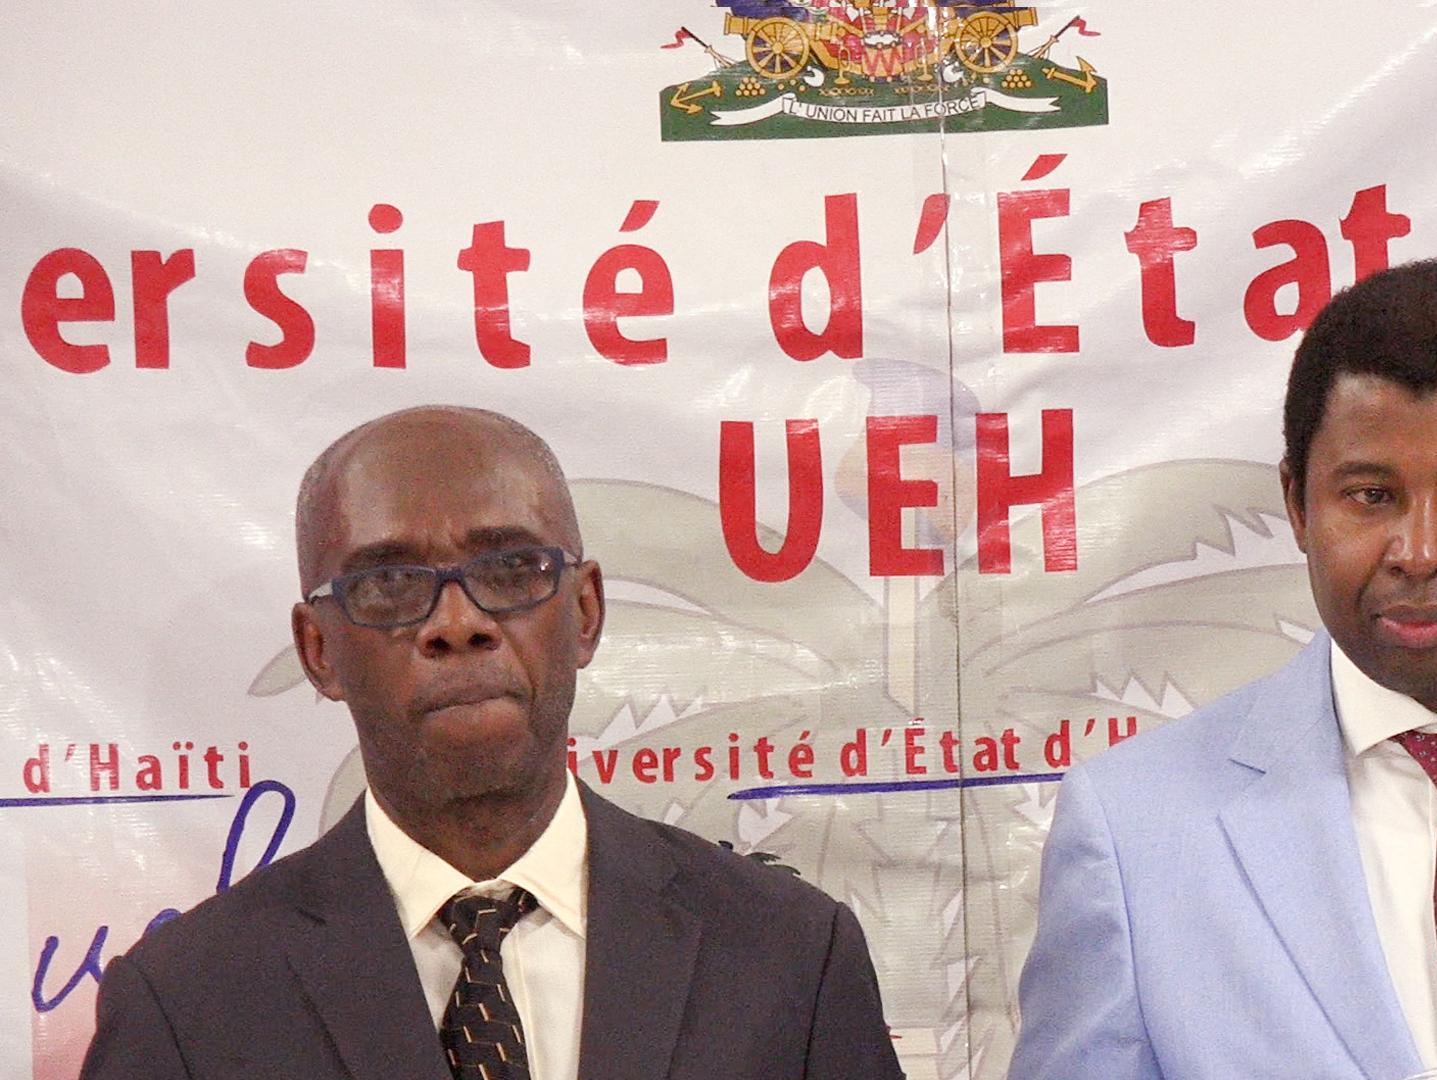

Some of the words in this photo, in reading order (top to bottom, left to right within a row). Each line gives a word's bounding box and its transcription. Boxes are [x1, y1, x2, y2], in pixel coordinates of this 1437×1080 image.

[805, 107, 857, 122] UNION
[862, 109, 896, 122] FAIT
[900, 107, 920, 120] LA
[924, 97, 980, 117] FORCE
[20, 199, 675, 375] ersité
[718, 407, 1079, 584] UEH
[22, 741, 252, 794] d'Haïti
[839, 717, 1021, 778] d'État
